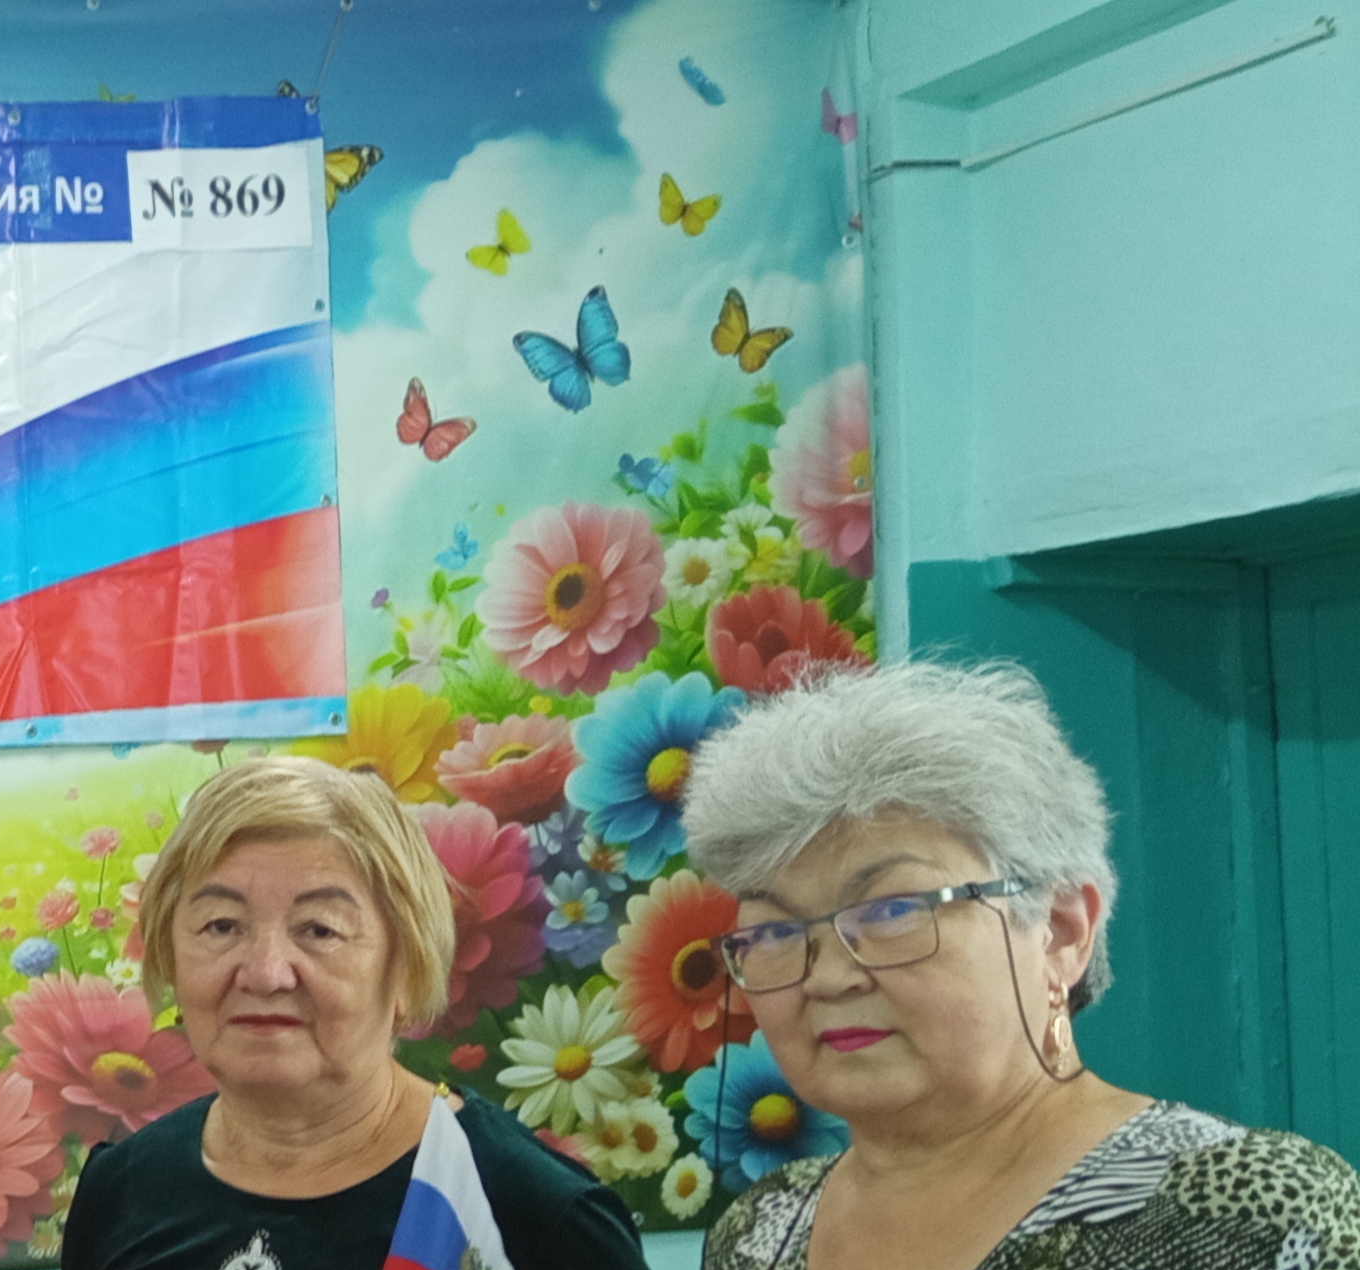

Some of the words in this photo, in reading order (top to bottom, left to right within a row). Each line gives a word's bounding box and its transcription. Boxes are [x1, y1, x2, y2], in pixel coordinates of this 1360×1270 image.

[54, 175, 104, 214] №
[142, 174, 194, 220] №
[209, 173, 286, 219] 869
